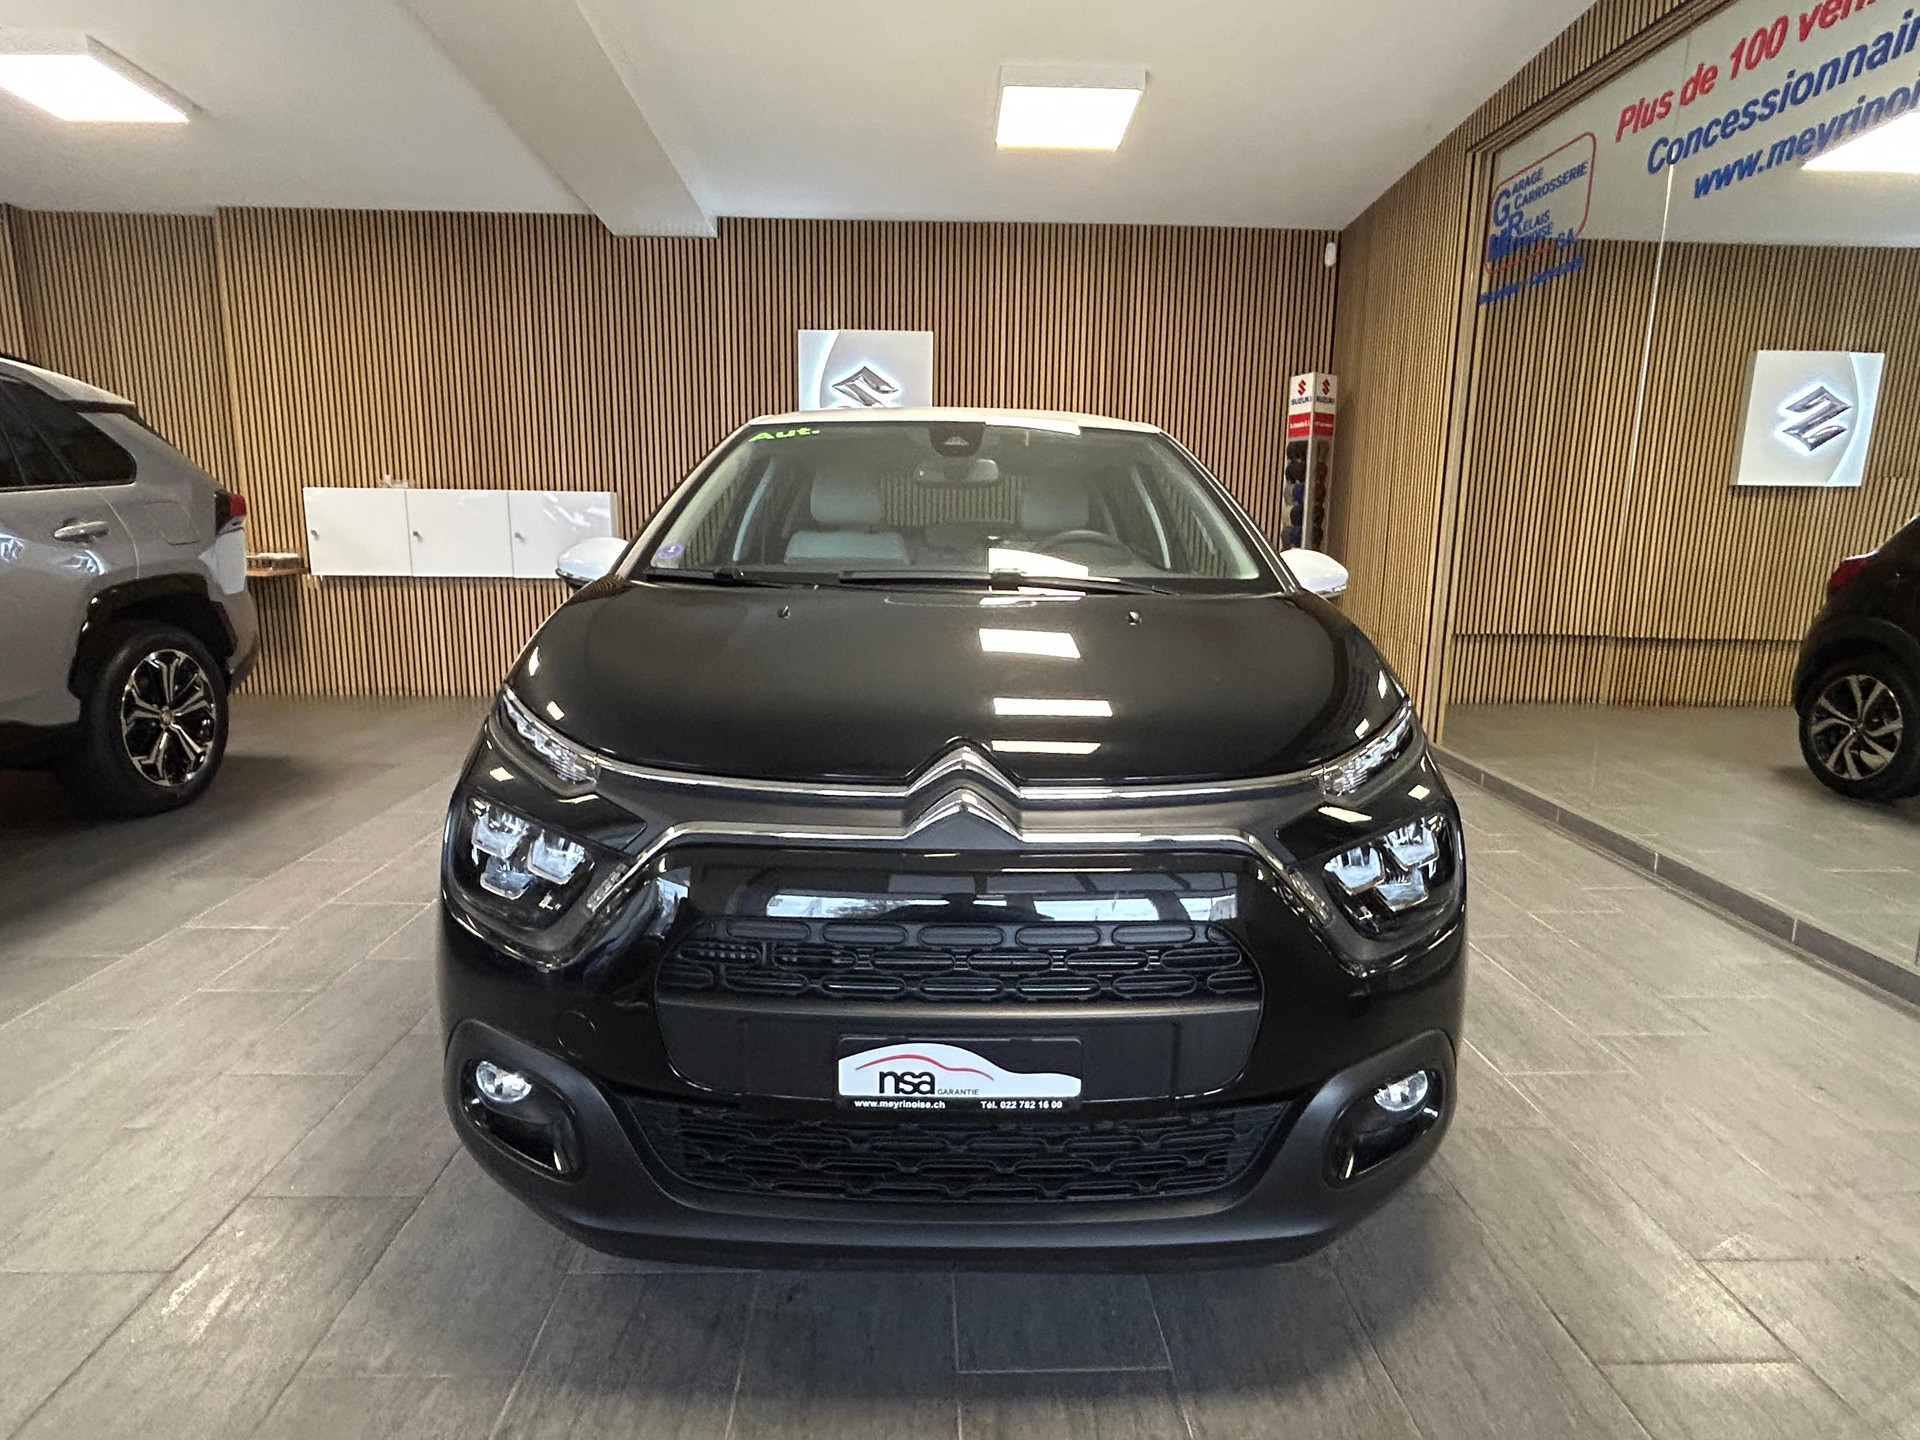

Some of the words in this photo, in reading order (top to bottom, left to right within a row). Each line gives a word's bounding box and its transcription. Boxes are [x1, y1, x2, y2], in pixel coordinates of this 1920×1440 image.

[1615, 90, 1674, 144] Plus
[1680, 62, 1719, 106] de
[1730, 15, 1789, 80] 100
[1514, 160, 1589, 210] CARROSSERIE
[1509, 210, 1551, 237] RELAIS
[748, 427, 820, 442] Aut.
[879, 1070, 936, 1095] nsa
[936, 1088, 980, 1096] GARANTIE
[854, 1099, 946, 1109] www.meyrinoise.ch
[1000, 1100, 1017, 1109] 022
[1051, 1100, 1063, 1109] 00
